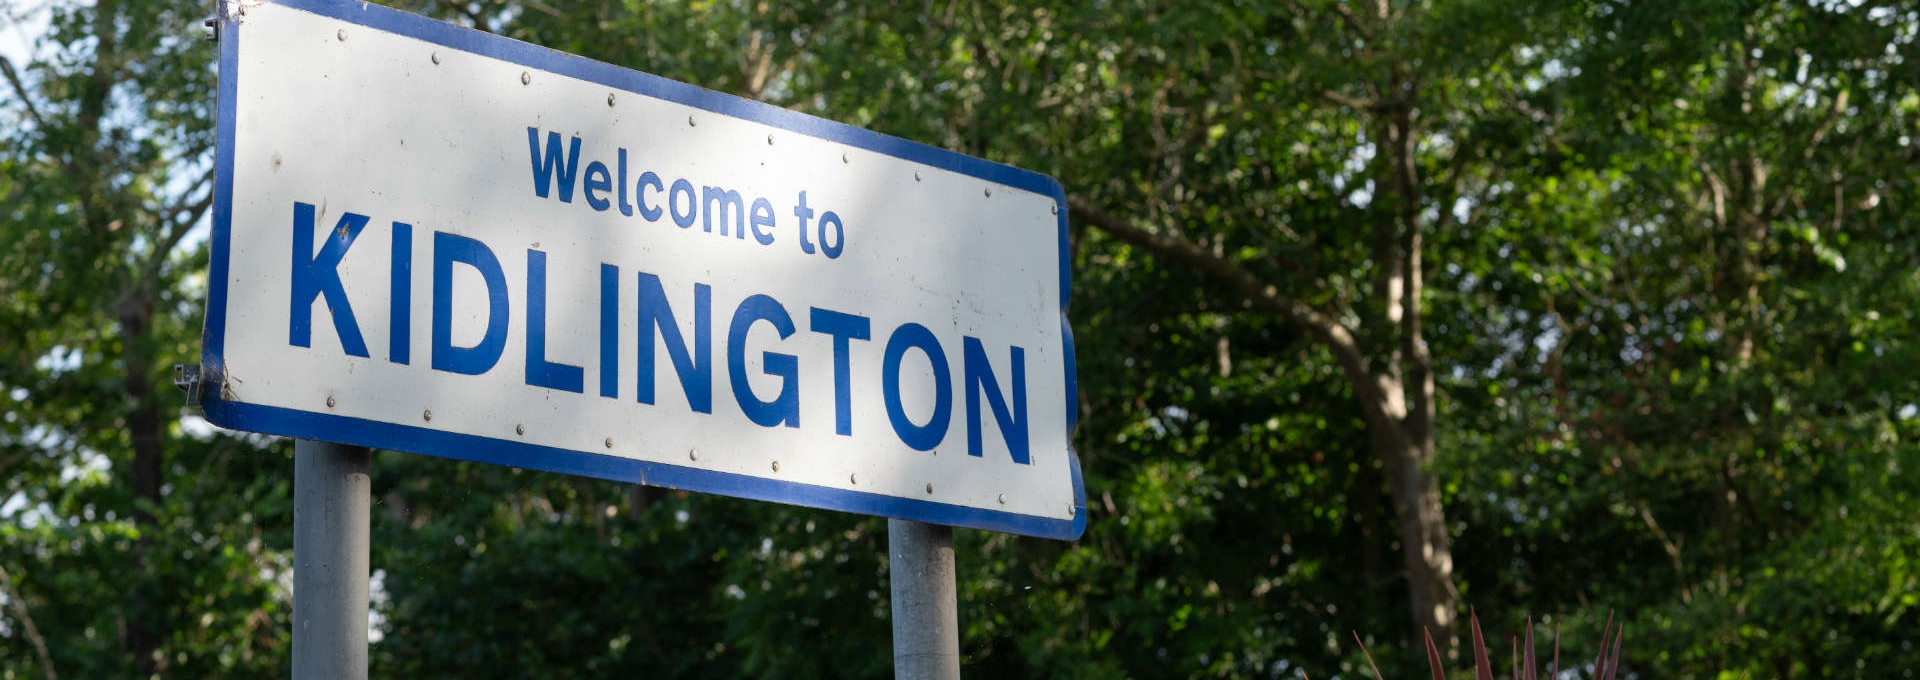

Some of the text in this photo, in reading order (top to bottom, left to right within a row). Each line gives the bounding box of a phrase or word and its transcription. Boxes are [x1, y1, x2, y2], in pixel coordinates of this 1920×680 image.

[527, 127, 845, 260] Welcome to
[288, 201, 1031, 465] KIDLINGTON
